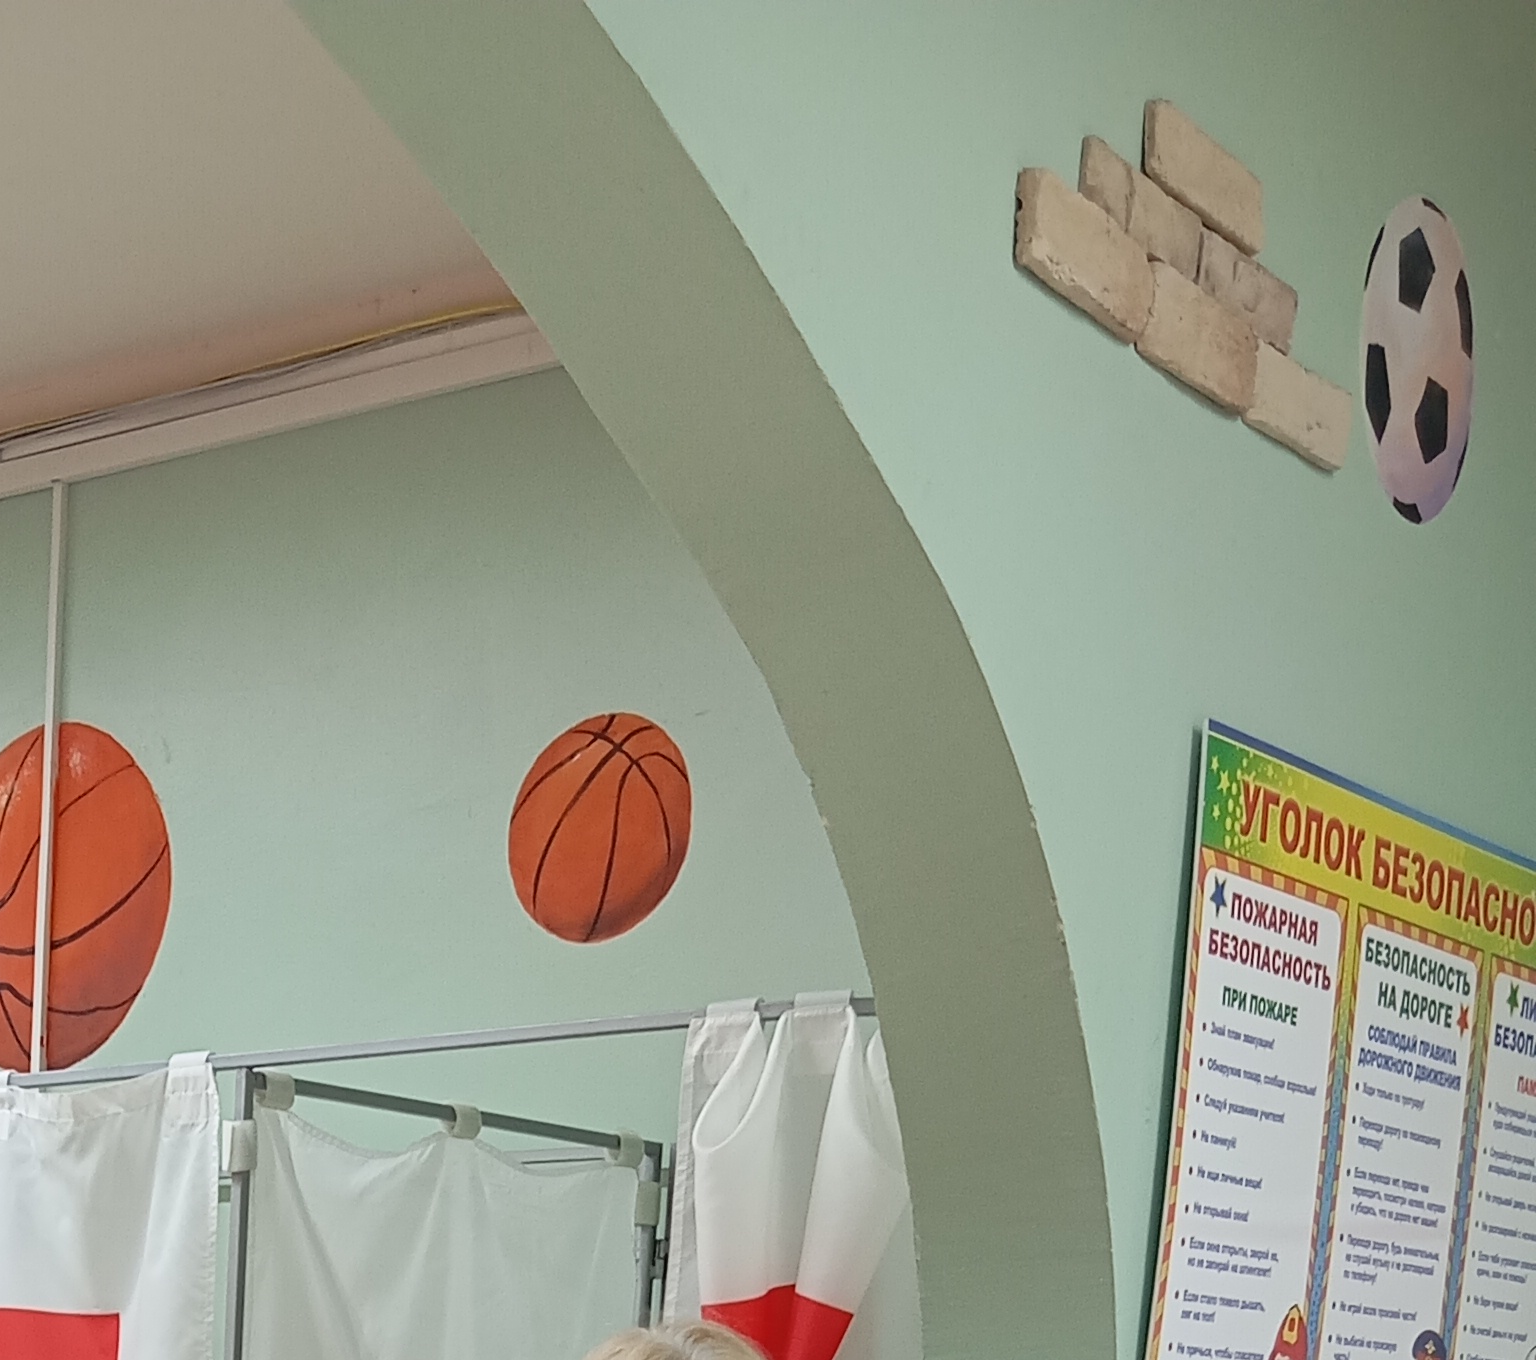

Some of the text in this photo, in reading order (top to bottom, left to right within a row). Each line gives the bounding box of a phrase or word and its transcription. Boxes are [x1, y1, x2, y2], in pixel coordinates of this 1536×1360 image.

[1240, 780, 1536, 945] УГОЛОК БЕЗОПАСНО
[1231, 892, 1318, 947] ПОЖАРНАЯ
[1208, 928, 1331, 991] БЕЗОПАСНОСТЬ
[1365, 937, 1470, 996] БЕЗОПАСНОСТЬ
[1222, 985, 1298, 1026] ПРИ ПОЖАРЕ
[1378, 981, 1453, 1028] НА ДОРОГЕ
[1358, 1048, 1413, 1077] ДОРОЖНОГО
[1368, 1025, 1456, 1066] СОБЛЮДАЙ ПРАВИЛА
